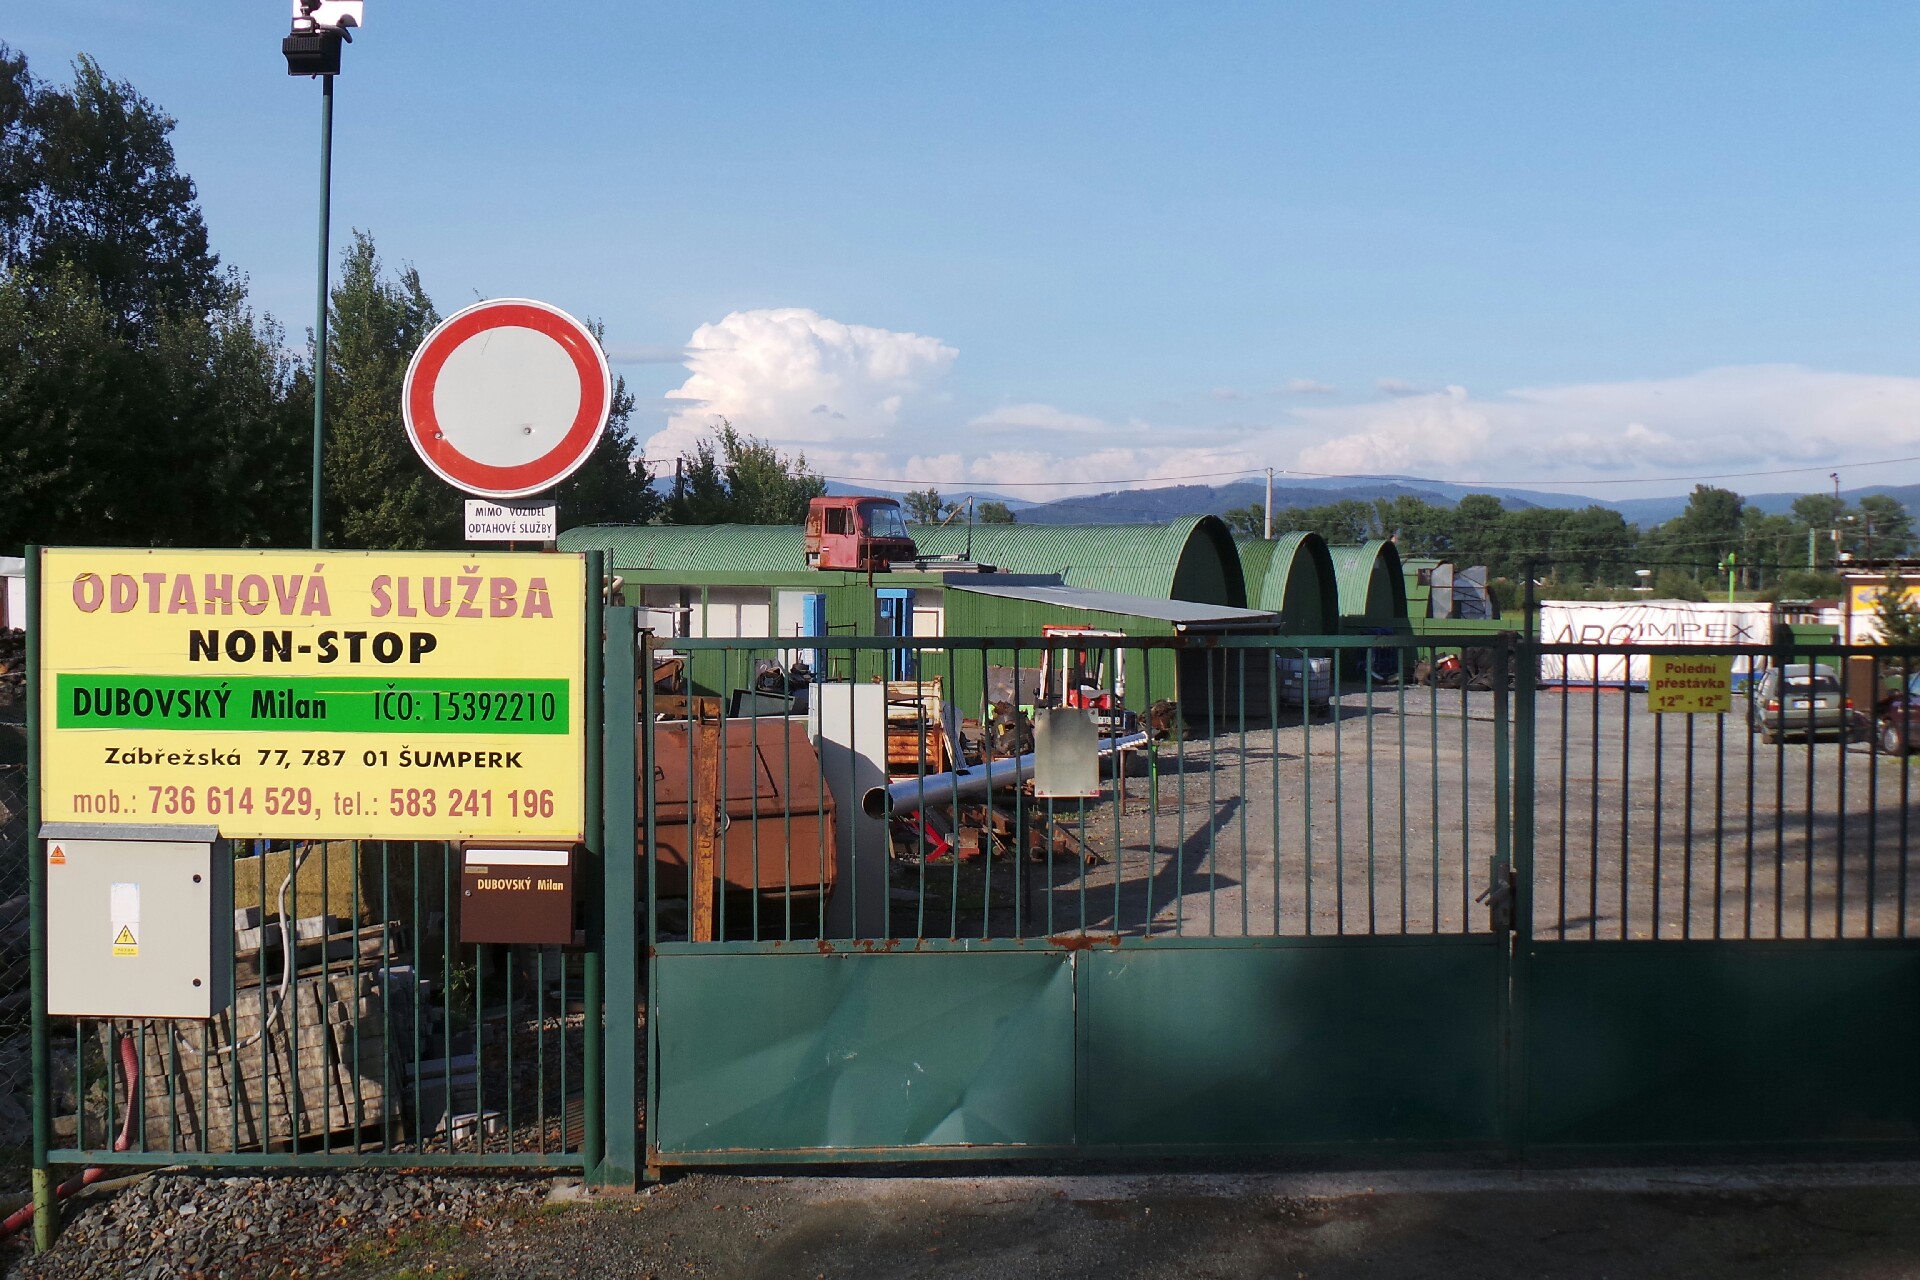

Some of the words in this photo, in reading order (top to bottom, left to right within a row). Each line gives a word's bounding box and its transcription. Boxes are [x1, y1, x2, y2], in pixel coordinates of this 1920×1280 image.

[475, 507, 503, 517] MIMO
[509, 507, 546, 517] VOZIDEL
[468, 520, 516, 534] ODTAHOVÉ
[519, 520, 552, 534] SLUŽBY
[73, 563, 332, 616] ODTAHOVÁ
[371, 565, 554, 619] SLUŽBA
[189, 629, 438, 664] NON-STOP
[1665, 662, 1716, 674] Polední
[1656, 677, 1725, 691] přestávka
[73, 681, 232, 719] DUBOVSKÝ
[251, 688, 327, 719] Milan
[374, 683, 422, 721] IČO:
[433, 692, 556, 722] 15392210
[104, 747, 241, 766] Zábřežská
[257, 749, 291, 769] 77,
[301, 750, 346, 767] 787
[363, 750, 388, 767] 01
[399, 745, 523, 768] ŠUMPERK
[73, 789, 136, 814] mob.:
[148, 785, 196, 815] 736
[207, 786, 253, 815] 614
[265, 786, 321, 821] 529,
[334, 791, 378, 816] tel.:
[390, 788, 437, 817] 583
[448, 789, 492, 817] 241
[508, 789, 554, 818] 196
[477, 876, 532, 890] DUBOVSKÝ
[537, 879, 564, 891] Milan
